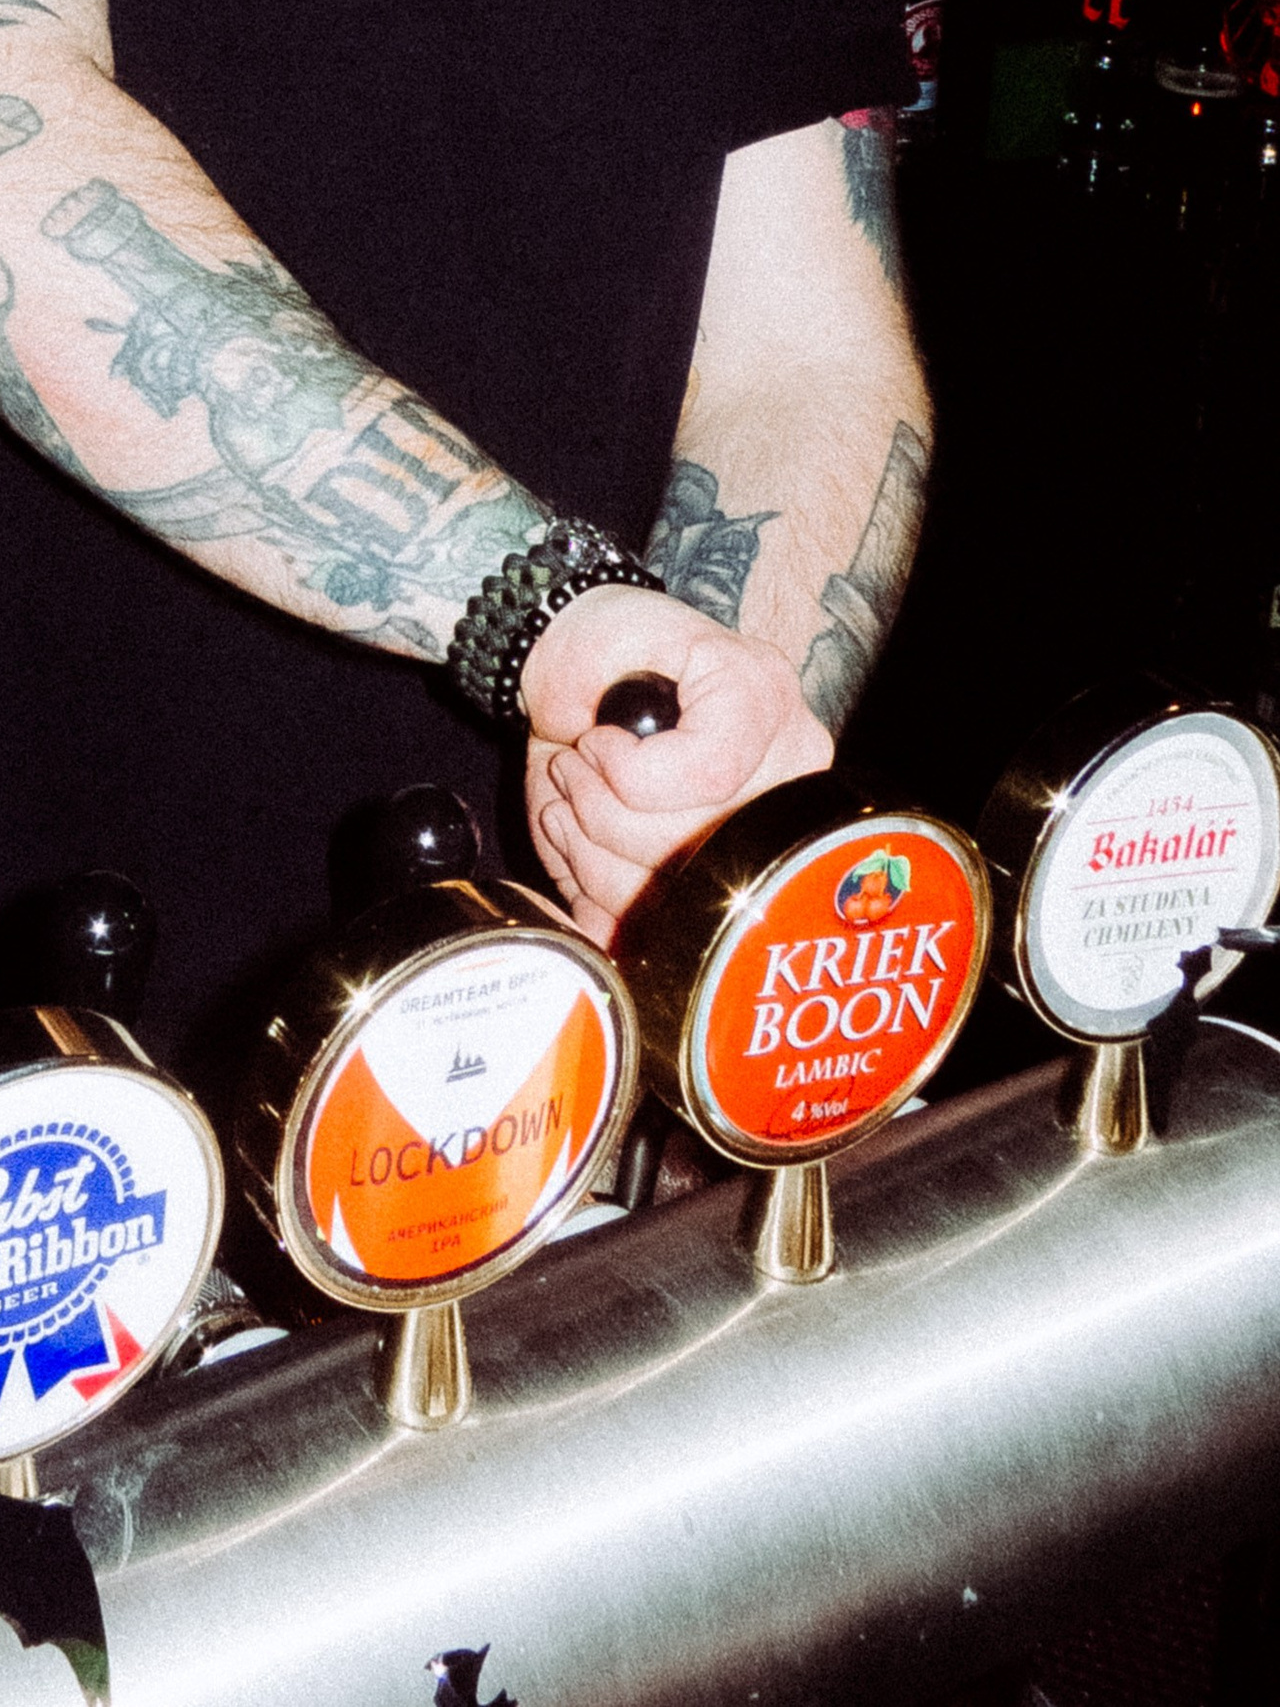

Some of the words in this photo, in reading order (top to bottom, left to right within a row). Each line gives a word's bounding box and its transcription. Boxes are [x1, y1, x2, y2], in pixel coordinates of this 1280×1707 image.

[756, 919, 956, 999] KRIEK
[400, 979, 502, 1015] DREAMTEAM
[743, 976, 945, 1059] BOON
[774, 1048, 883, 1090] LAMBIC
[350, 1094, 565, 1188] LOCKDOWN
[429, 1233, 462, 1254] IPA
